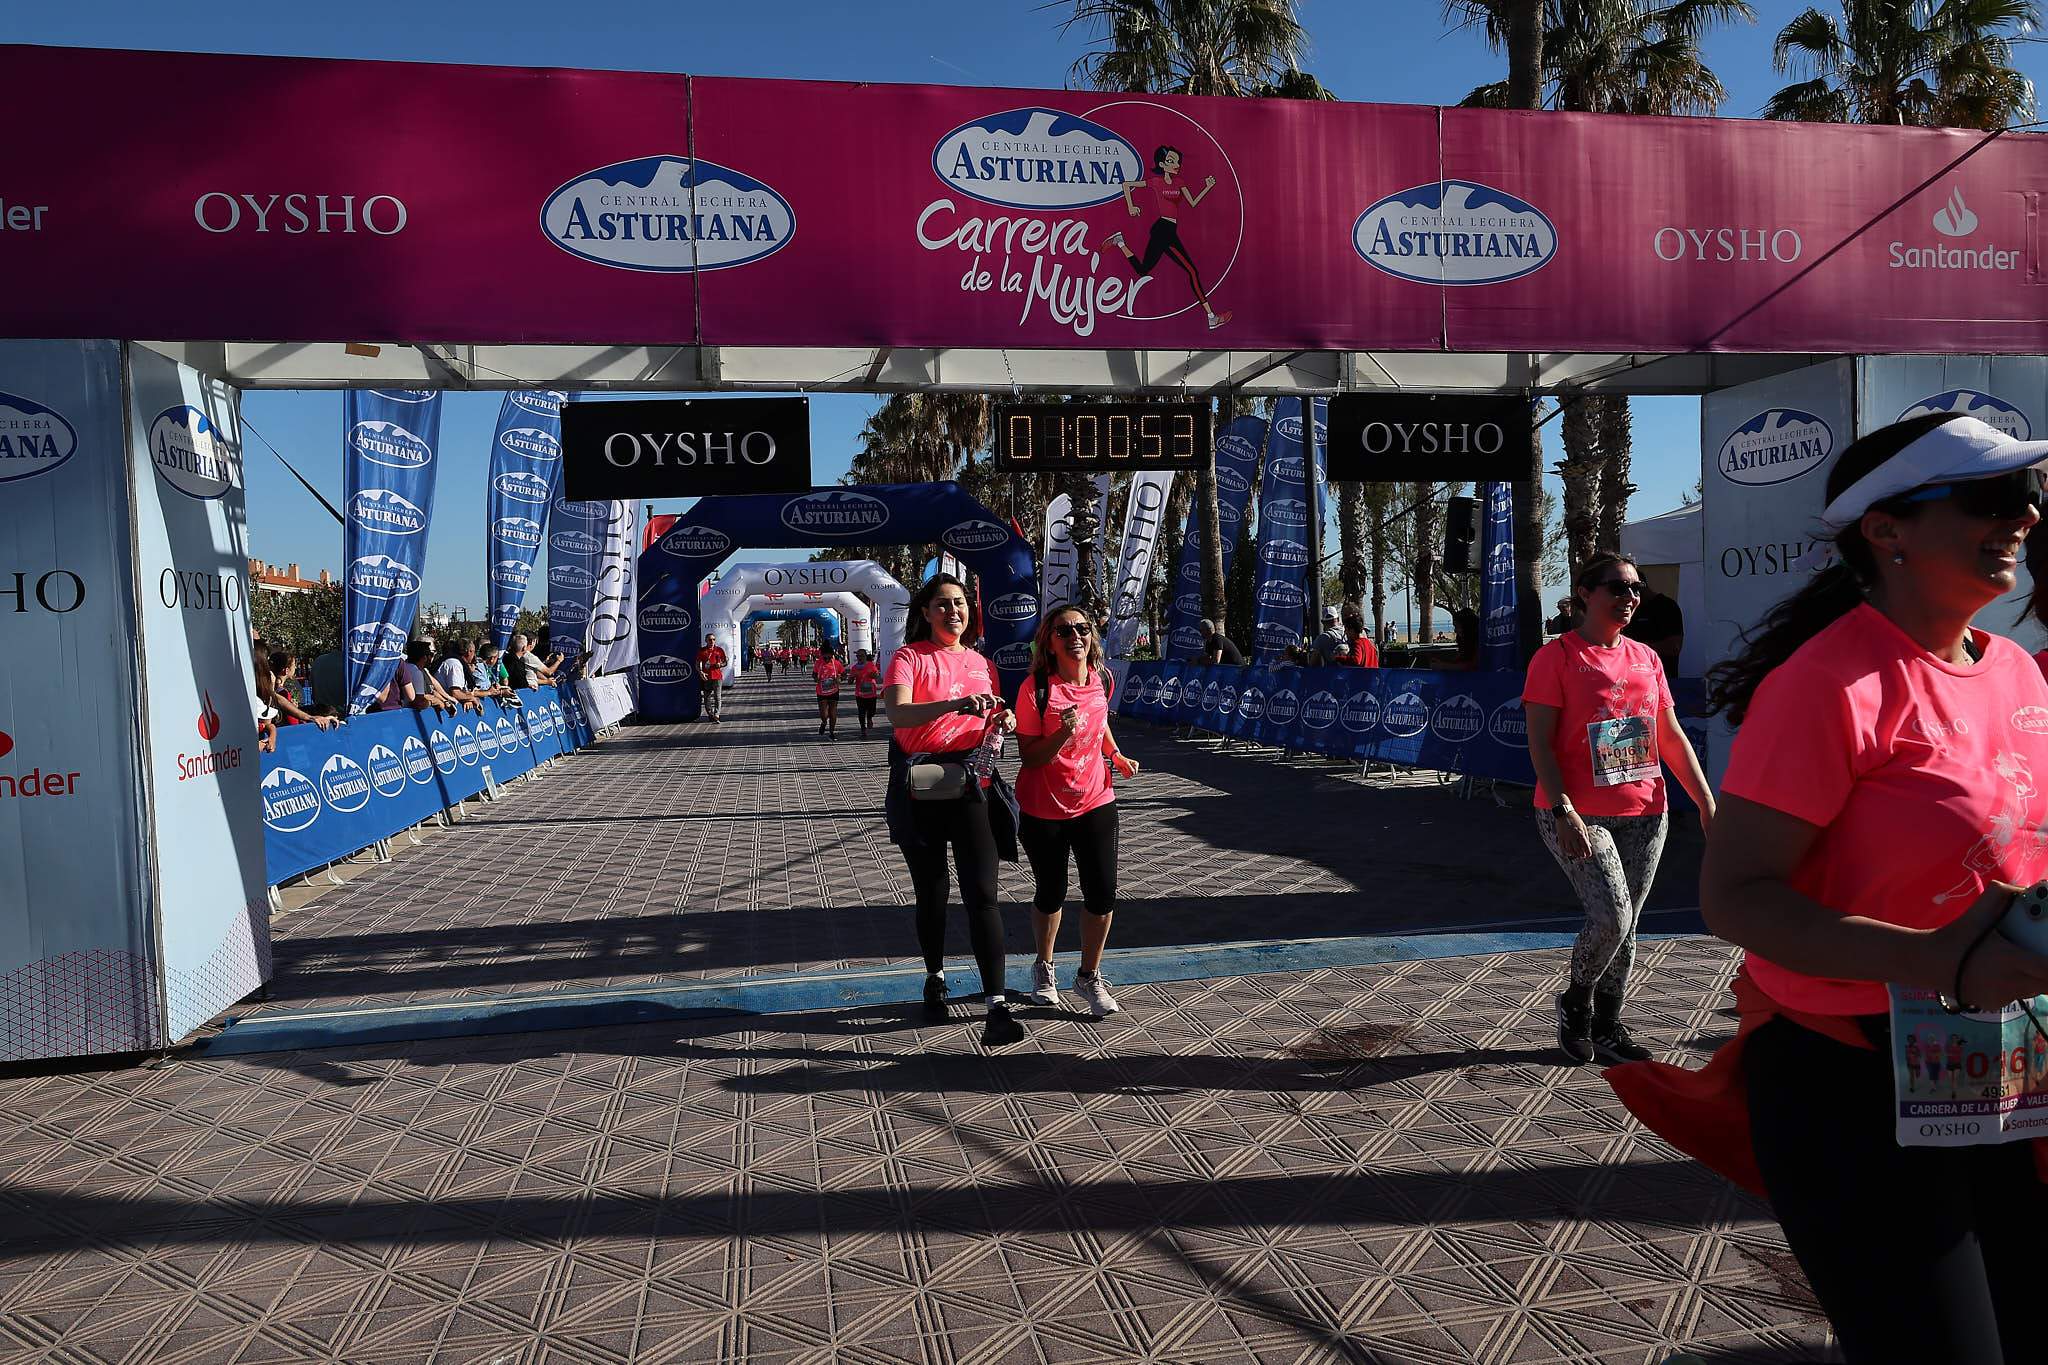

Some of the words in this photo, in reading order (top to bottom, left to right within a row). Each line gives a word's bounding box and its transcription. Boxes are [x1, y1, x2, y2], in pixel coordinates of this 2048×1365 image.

[982, 140, 1049, 153] CENTRAL
[1055, 142, 1120, 156] LECHERA
[949, 142, 1125, 185] ASTURIANA
[194, 192, 408, 235] OYSHO
[600, 196, 680, 207] CENTRAL
[687, 197, 768, 208] LECHERA
[562, 196, 777, 242] ASTURIANA
[916, 199, 1090, 256] Carrera
[1400, 216, 1463, 226] CENTRAL
[1471, 217, 1535, 228] LECHERA
[1368, 217, 1542, 258] ASTURIANA
[1654, 227, 1802, 262] OYSHO
[1888, 240, 2020, 270] Santander
[960, 255, 993, 292] de
[1000, 254, 1023, 293] la
[1019, 252, 1154, 337] Mujer
[355, 429, 425, 463] ASTURIANA
[604, 431, 777, 467] OYSHO
[1361, 422, 1504, 454] OYSHO
[1741, 433, 1776, 449] CENTRAL
[1780, 425, 1820, 441] LECHERA
[157, 429, 231, 483] ASTURIANA
[1725, 437, 1824, 473] ASTURIANA
[353, 499, 419, 529] ASTURIANA
[559, 500, 603, 517] ASTURIANA
[790, 505, 882, 525] ASTURIANA
[553, 536, 599, 553] ASTURIANA
[666, 539, 725, 550] ASTURIANA
[948, 531, 1004, 544] ASTURIANA
[1116, 481, 1163, 620] OYSHO
[591, 500, 623, 645] OYSHO
[764, 567, 848, 586] OYSHO
[1046, 519, 1073, 609] YSHO
[160, 568, 240, 612] OYSHO
[641, 615, 687, 626] ASTURIANA
[641, 665, 688, 678] ASTURIANA
[1436, 716, 1479, 732] ASTURIANA
[177, 745, 242, 781] Santander
[372, 765, 405, 787] ASTURIANA
[325, 777, 369, 802] ASTURIANA
[263, 791, 319, 821] ASTURIANA
[1910, 1103, 1958, 1115] CARRERA
[1961, 1102, 1974, 1113] DE
[1978, 1102, 1990, 1113] LA
[1920, 1121, 1981, 1137] OYSHO
